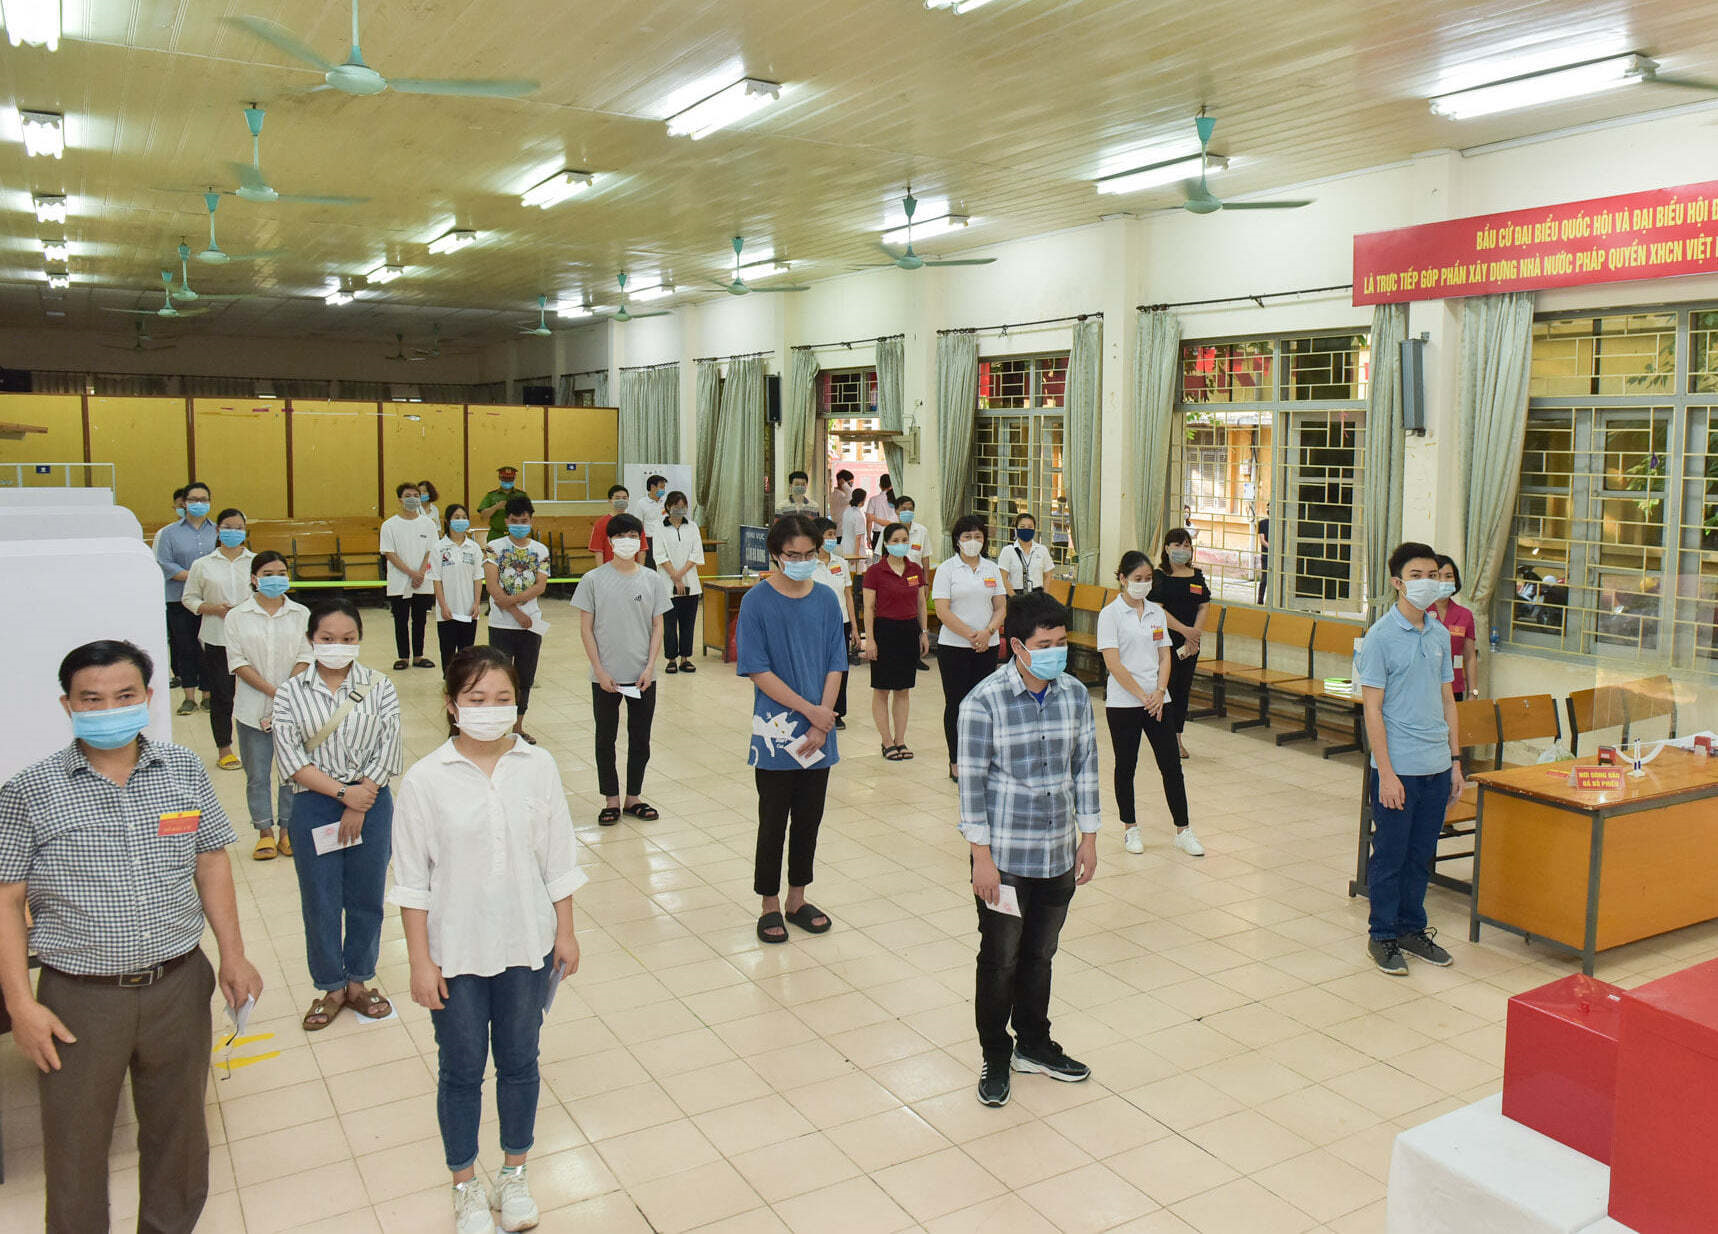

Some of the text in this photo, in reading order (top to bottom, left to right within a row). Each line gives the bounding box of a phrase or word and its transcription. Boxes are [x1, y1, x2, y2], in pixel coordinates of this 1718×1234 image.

[1499, 221, 1514, 248] CỬ
[1515, 224, 1532, 249] ĐẠI
[1535, 214, 1559, 243] BIỂU
[1561, 210, 1591, 242] QUỐC
[1593, 209, 1612, 239] HỘI
[1616, 206, 1629, 232] VÀ
[1633, 207, 1653, 234] ĐẠI
[1656, 195, 1684, 227] BIỂU
[1687, 195, 1709, 227] HỘI
[1364, 272, 1374, 294] LÀ
[1377, 272, 1397, 296] TRỰC
[1400, 265, 1418, 291] TIẾP
[1421, 266, 1439, 288] GÓP
[1441, 259, 1467, 286] PHẦN
[1469, 260, 1488, 284] XÂY
[1490, 258, 1517, 286] DỰNG
[1520, 253, 1540, 278] NHÀ
[1544, 250, 1573, 276] NƯỚC
[1576, 247, 1605, 272] PHÁP
[1609, 238, 1647, 270] QUYỀN
[1649, 240, 1682, 264] XHCN
[1686, 233, 1712, 264] VIỆT
